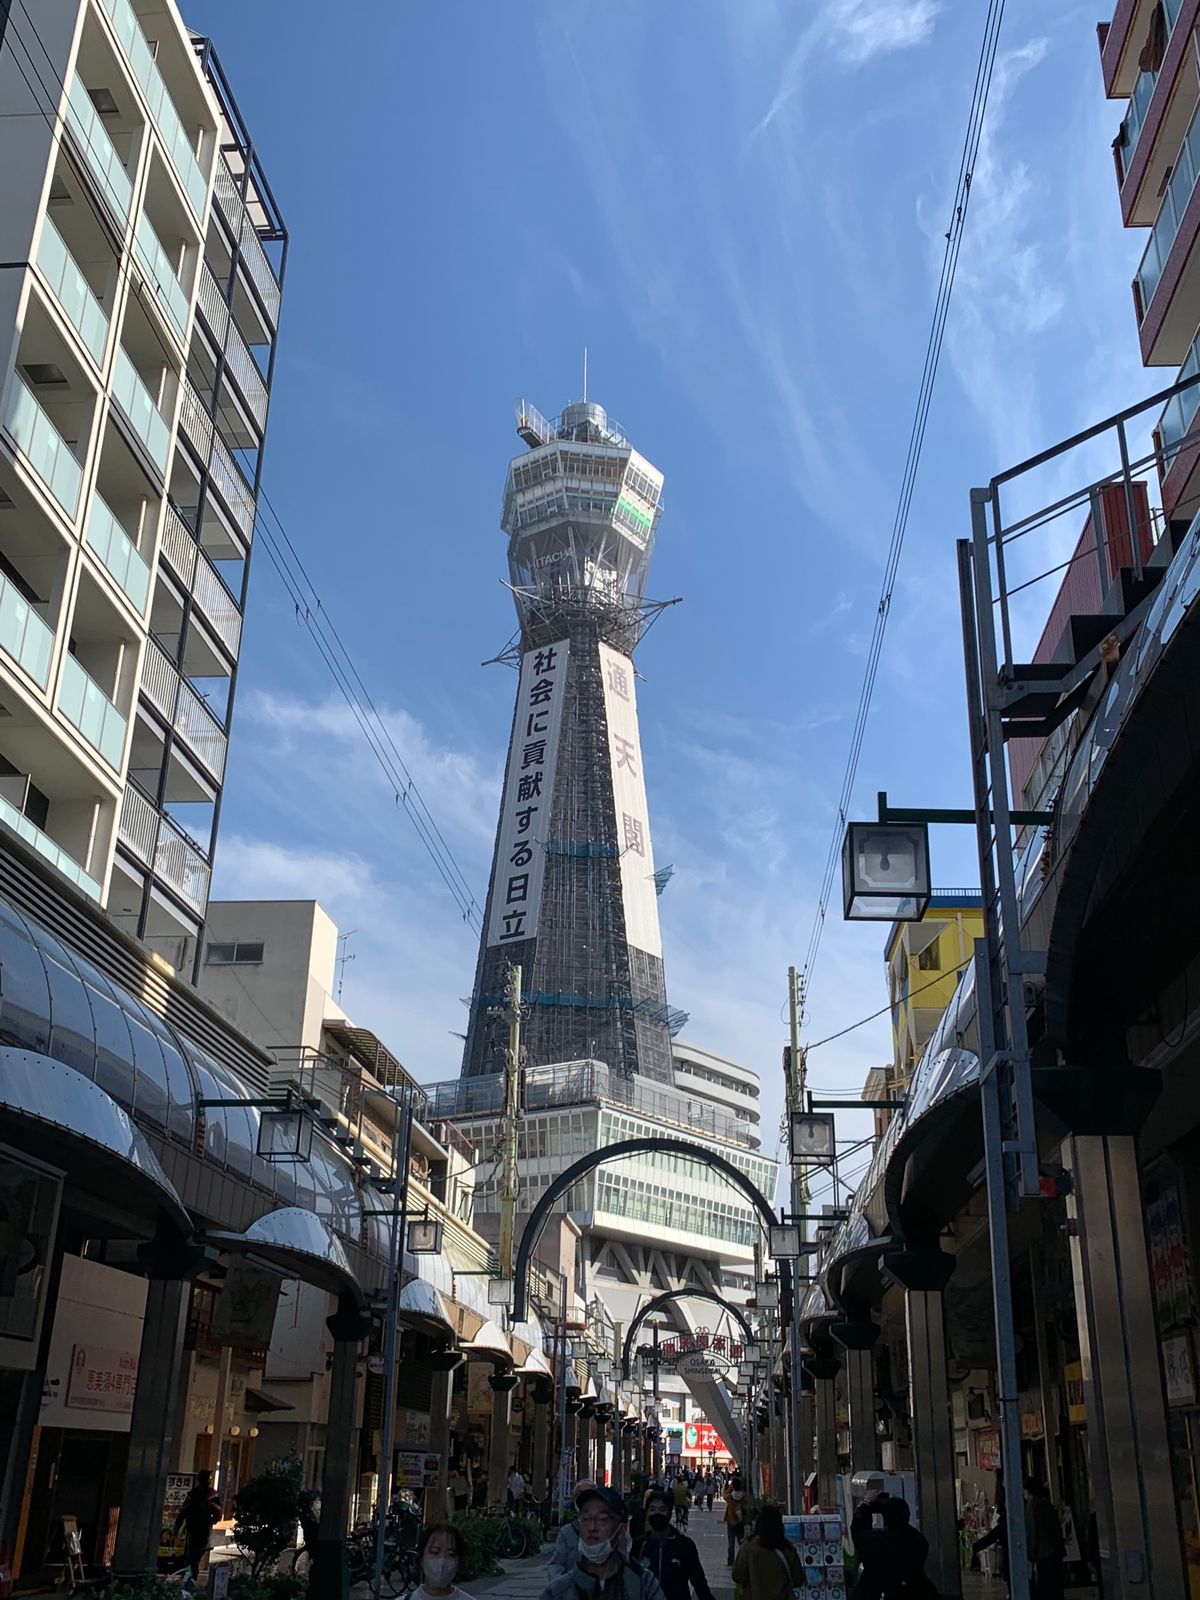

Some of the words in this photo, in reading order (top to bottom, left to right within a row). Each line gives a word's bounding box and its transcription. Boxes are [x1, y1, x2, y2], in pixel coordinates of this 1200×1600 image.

[499, 647, 557, 941] 社会に貢献する日立
[607, 659, 645, 858] 通天閣
[684, 1367, 722, 1375] SHINSEKAI
